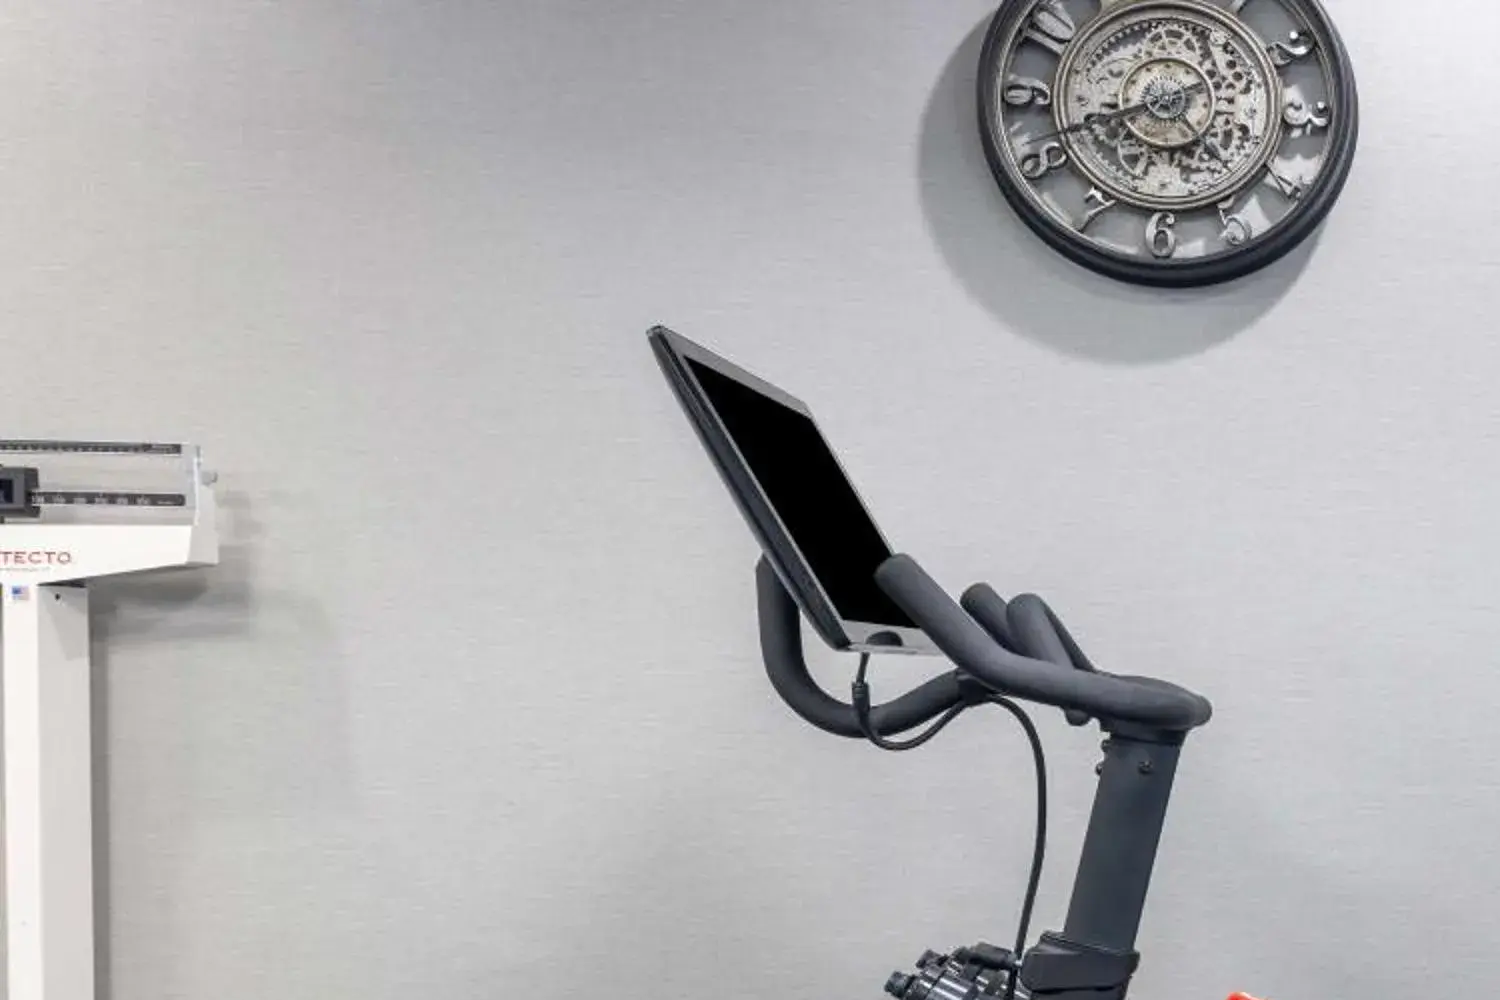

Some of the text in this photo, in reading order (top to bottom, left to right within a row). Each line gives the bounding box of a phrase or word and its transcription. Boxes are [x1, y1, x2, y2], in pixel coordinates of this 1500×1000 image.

[1023, 0, 1075, 55] 10
[1266, 31, 1317, 66] 2
[1003, 76, 1050, 106] 9
[1282, 100, 1331, 127] 3
[1020, 141, 1067, 179] 8
[1263, 163, 1304, 201] 4
[1077, 187, 1117, 233] 7
[1216, 196, 1252, 245] 5
[1145, 211, 1176, 258] 6
[0, 551, 71, 565] TECTO
